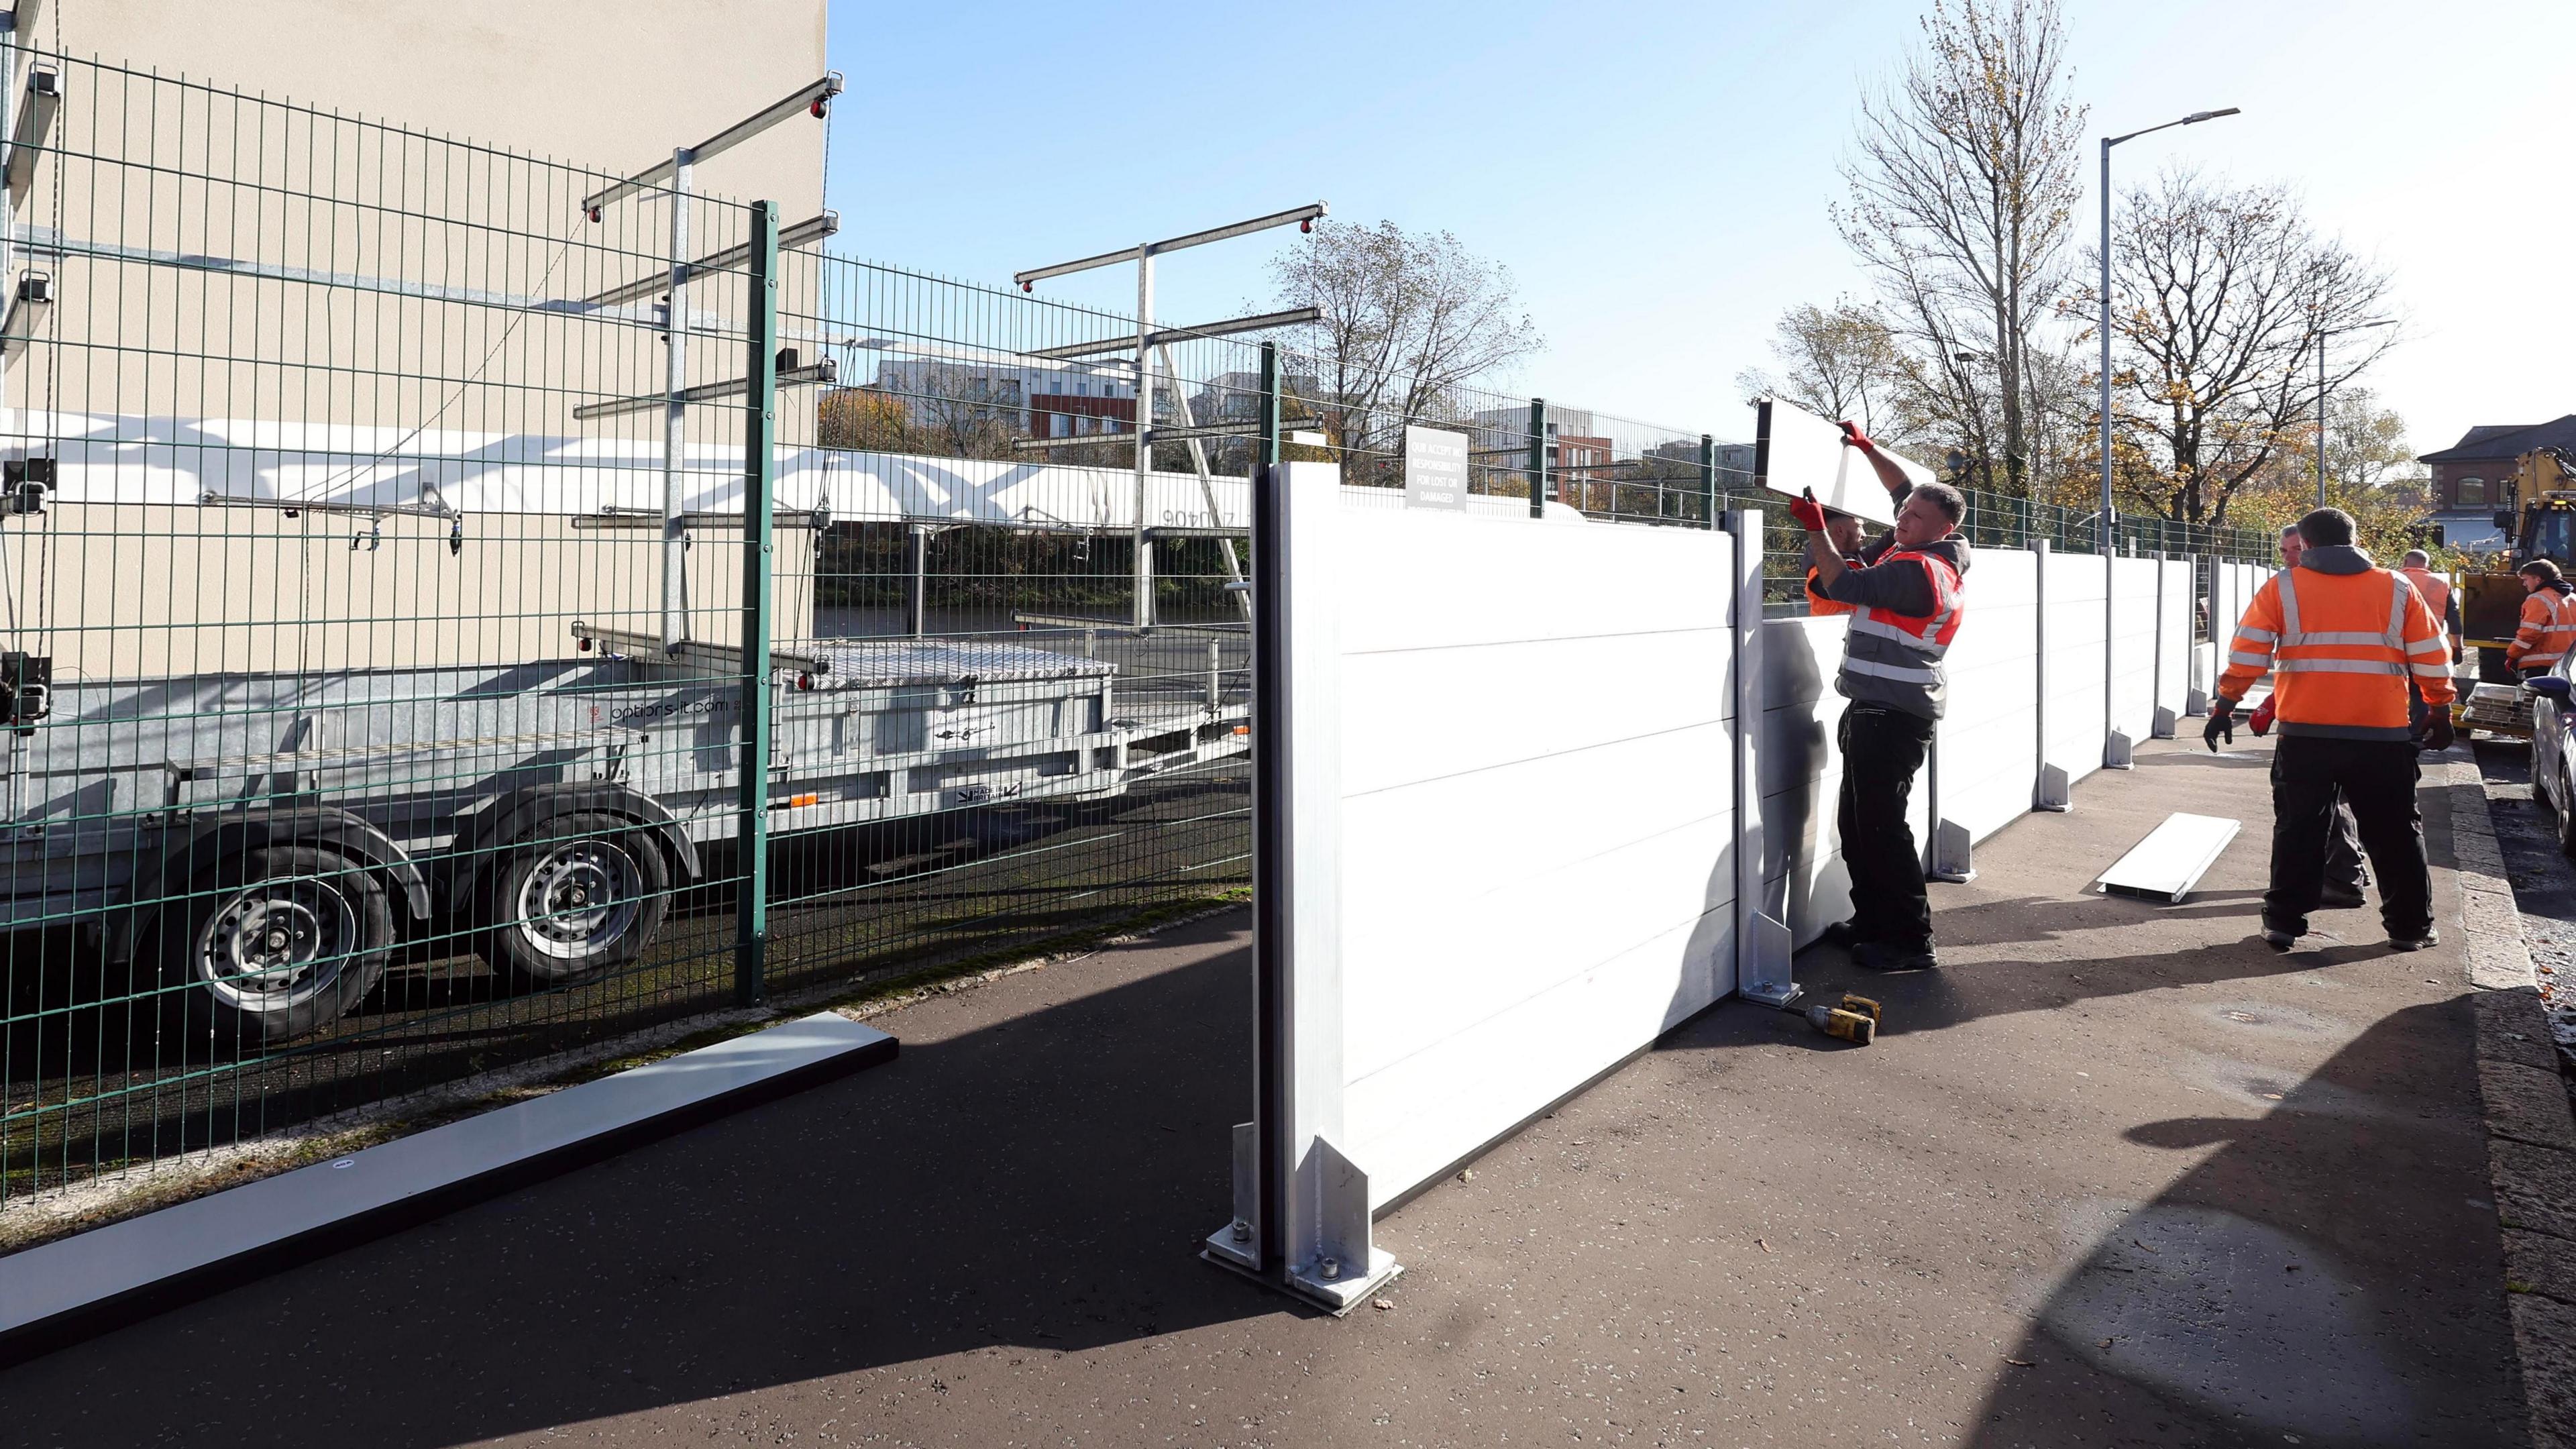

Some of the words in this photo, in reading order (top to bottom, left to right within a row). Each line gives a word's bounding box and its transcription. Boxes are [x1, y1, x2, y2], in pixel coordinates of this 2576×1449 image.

[1411, 441, 1426, 453] QUB
[1428, 443, 1452, 456] ACCEPT
[1452, 446, 1462, 458] NO
[1413, 458, 1461, 472] RESPONSIBILITY
[1416, 474, 1430, 486] FOR
[1431, 476, 1448, 487] LOST
[1448, 478, 1458, 489] OR
[1420, 491, 1454, 503] DAMAGED
[612, 701, 729, 723] options-it.com
[973, 792, 1003, 801] BRITAIN
